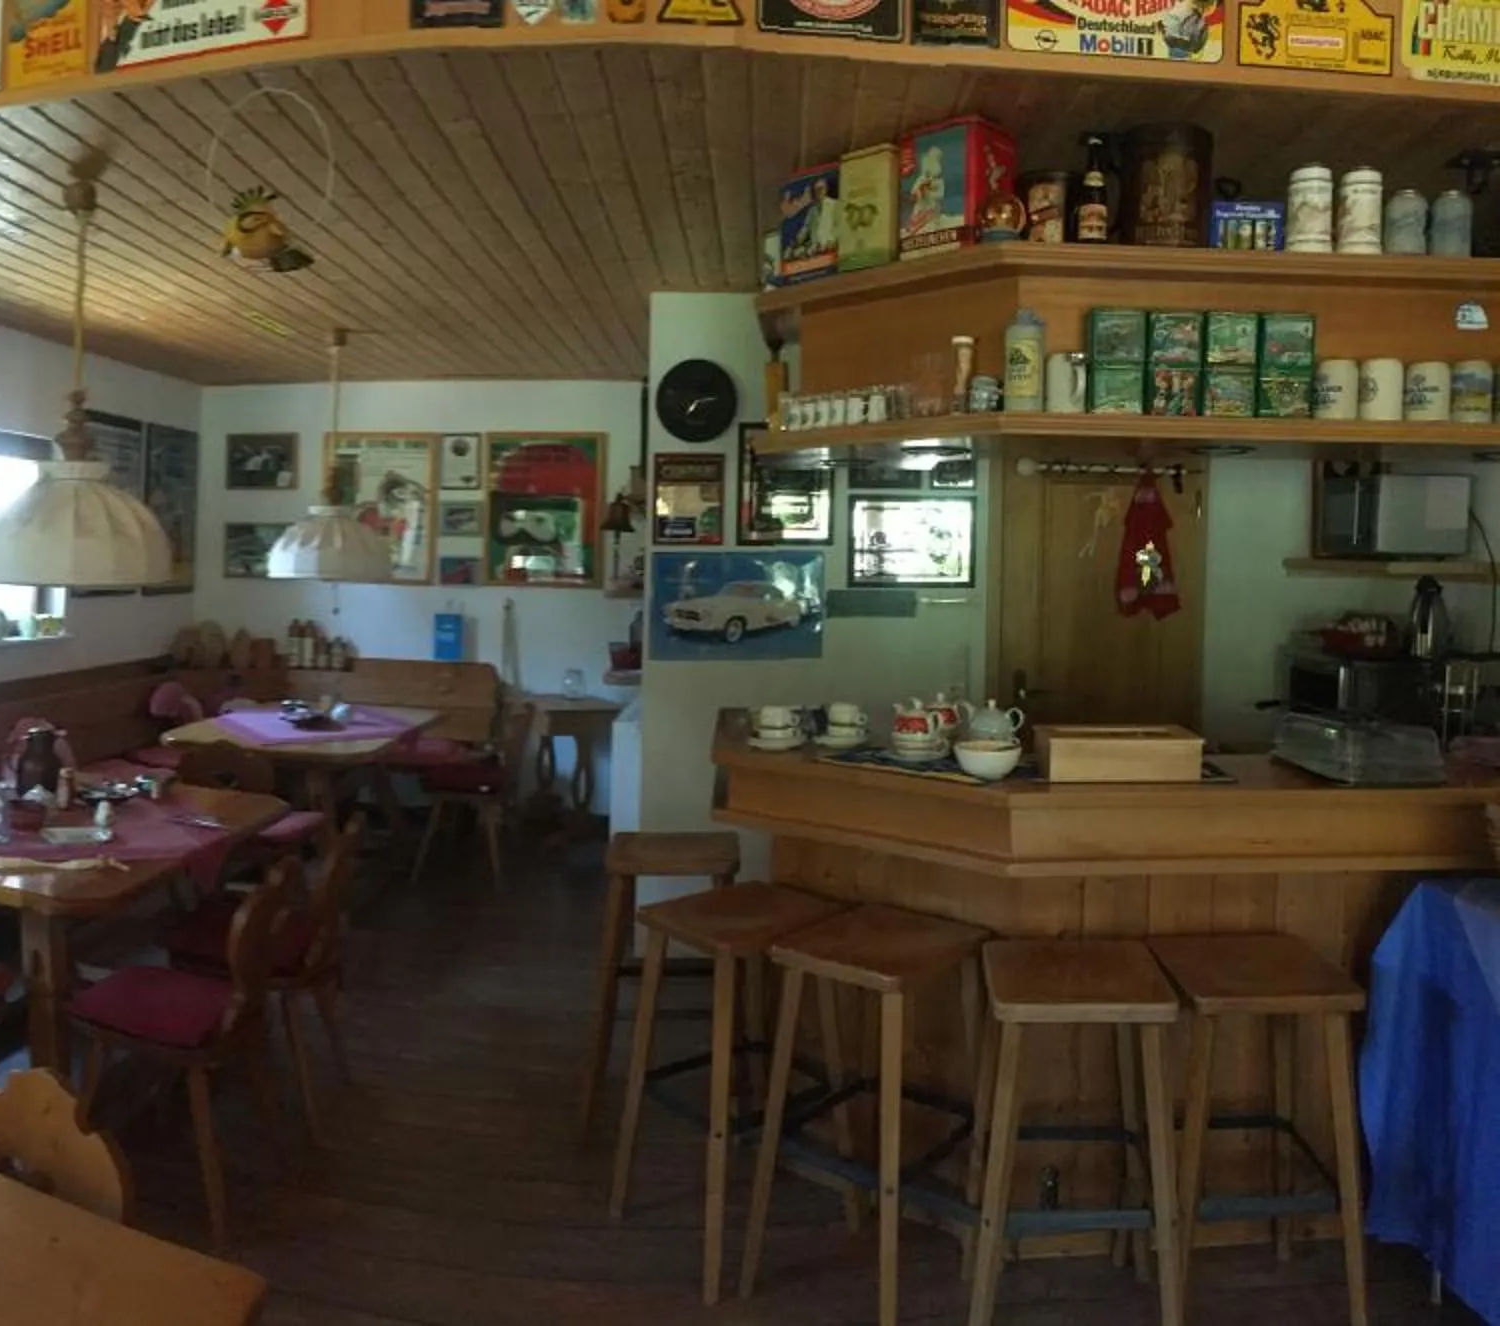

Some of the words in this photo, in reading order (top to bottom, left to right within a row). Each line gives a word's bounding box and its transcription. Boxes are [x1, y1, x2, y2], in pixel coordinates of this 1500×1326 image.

[1076, 17, 1157, 35] Deutschland
[24, 27, 83, 59] SHELL
[1078, 33, 1135, 54] Mobil
